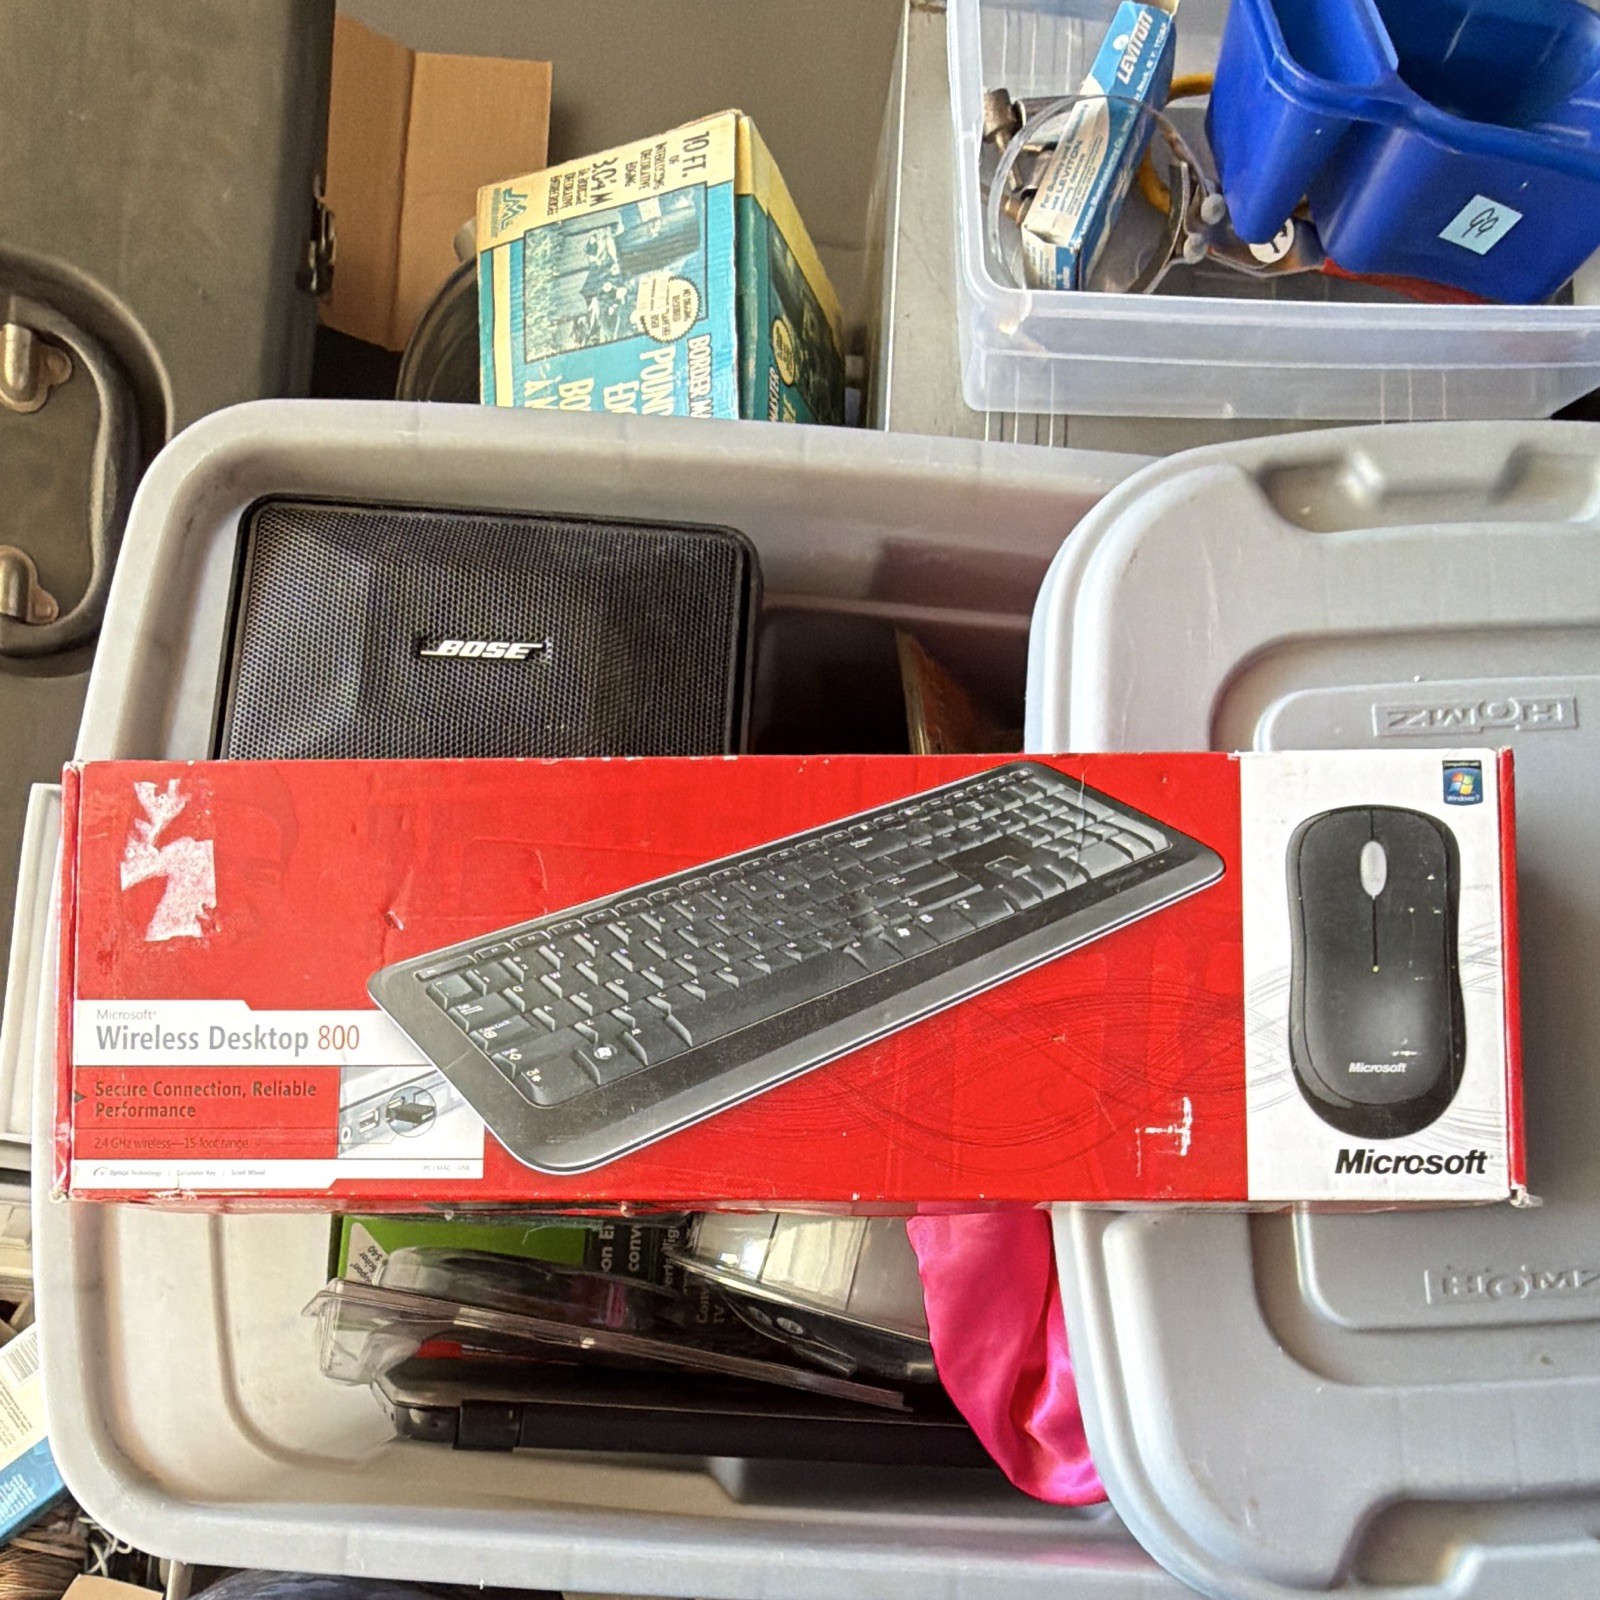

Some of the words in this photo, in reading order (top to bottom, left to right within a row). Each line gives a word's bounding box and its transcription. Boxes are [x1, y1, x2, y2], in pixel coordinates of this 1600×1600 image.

[1116, 10, 1154, 84] LEVITON
[683, 131, 710, 152] 10
[682, 154, 706, 178] FT.
[590, 192, 614, 207] M
[687, 334, 712, 399] BORDER
[420, 640, 543, 659] BOSE
[1388, 698, 1563, 729] HOMZ
[96, 1008, 153, 1022] Microsoft
[96, 1025, 200, 1051] Wireless
[209, 1024, 309, 1056] Desktop
[318, 1024, 360, 1051] 800
[1348, 1061, 1407, 1074] Microsoft
[95, 1081, 148, 1098] Secure
[152, 1080, 247, 1100] Connection,
[252, 1080, 317, 1097] Reliable
[95, 1103, 196, 1119] Performance
[94, 1138, 110, 1149] 2.4
[111, 1138, 132, 1149] GHz
[222, 1139, 249, 1152] range
[1335, 1148, 1488, 1175] Microsoft
